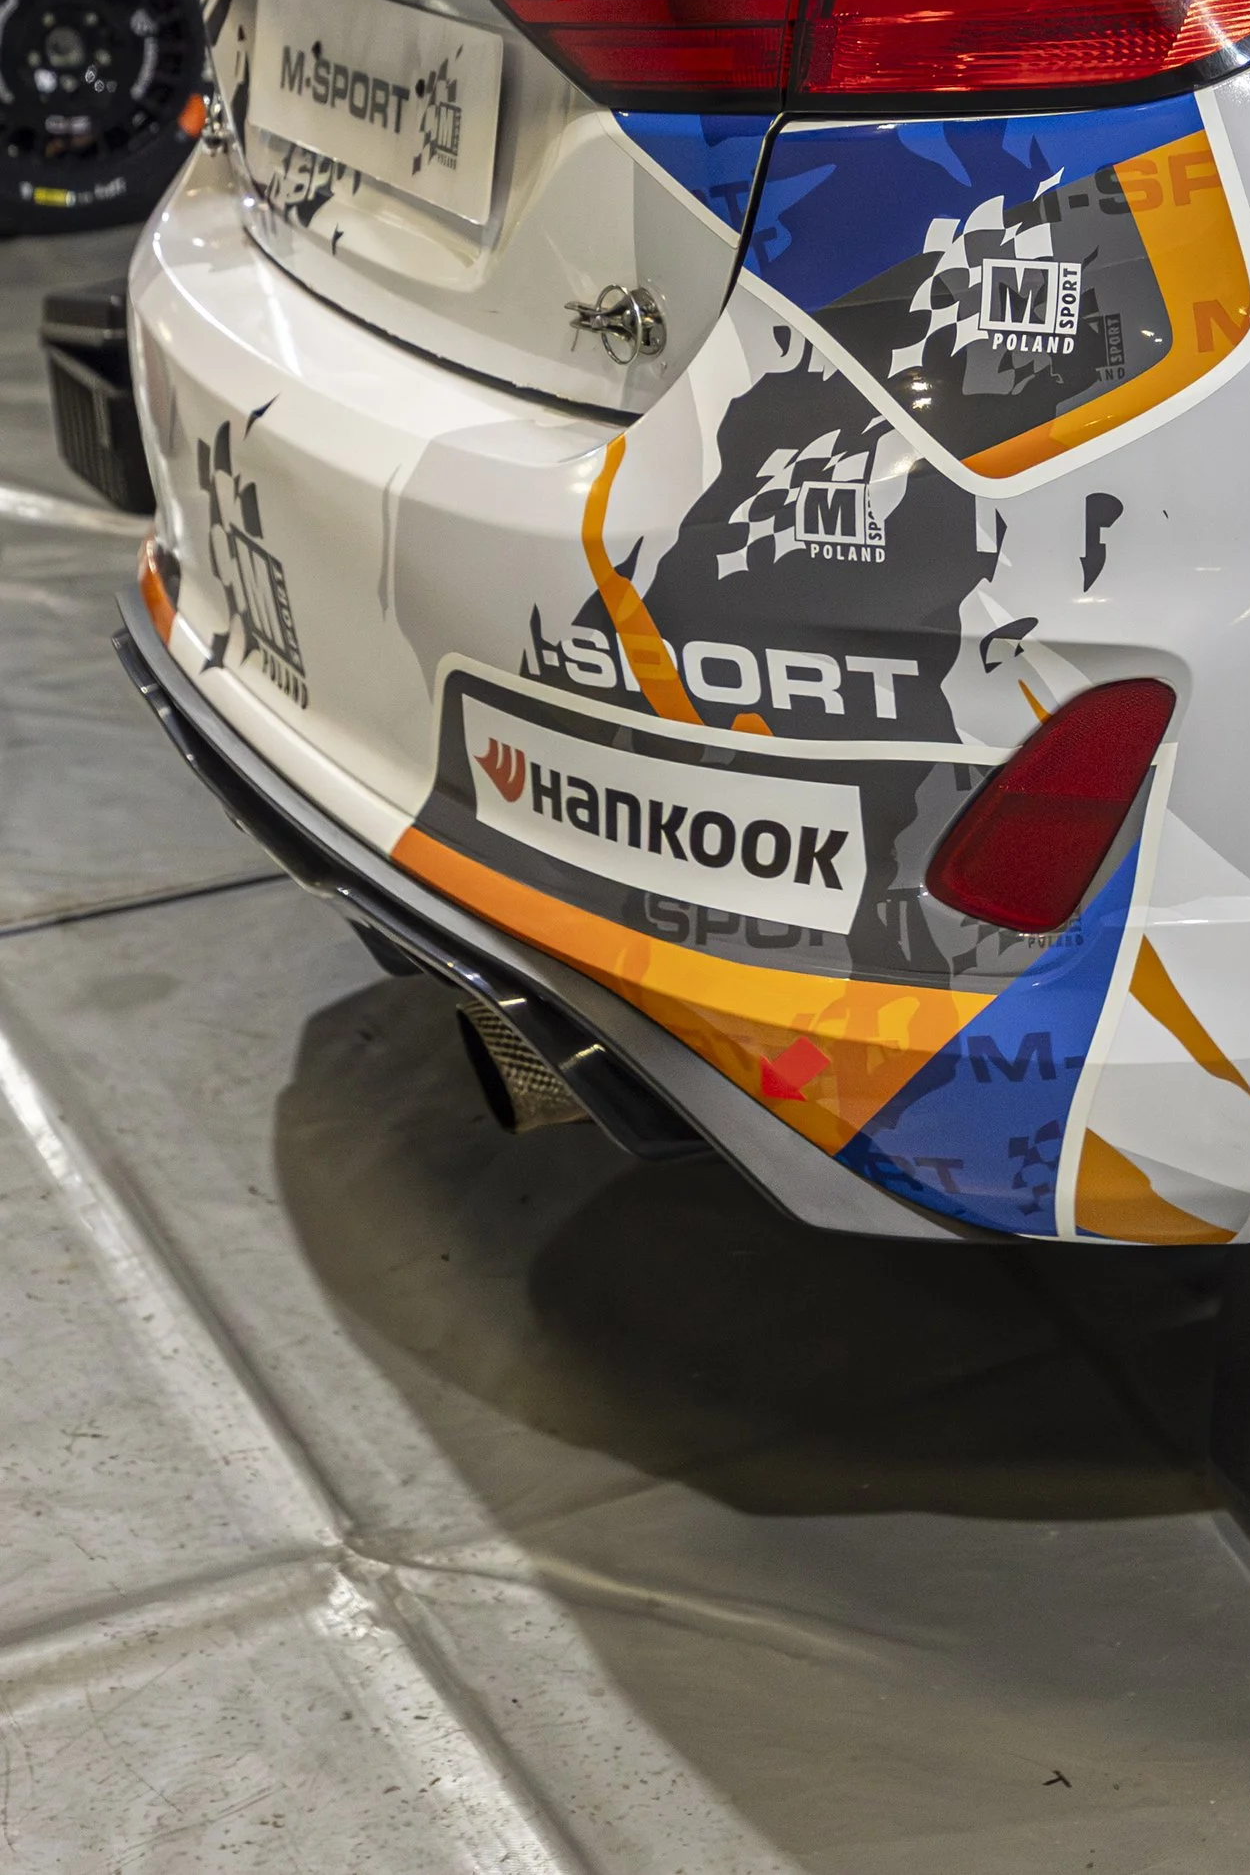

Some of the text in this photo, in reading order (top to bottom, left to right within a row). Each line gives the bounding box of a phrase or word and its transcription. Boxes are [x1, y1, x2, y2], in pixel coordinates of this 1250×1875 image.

[1059, 267, 1078, 329] SPORT
[991, 333, 1075, 355] POLAND
[810, 543, 886, 563] POLAND
